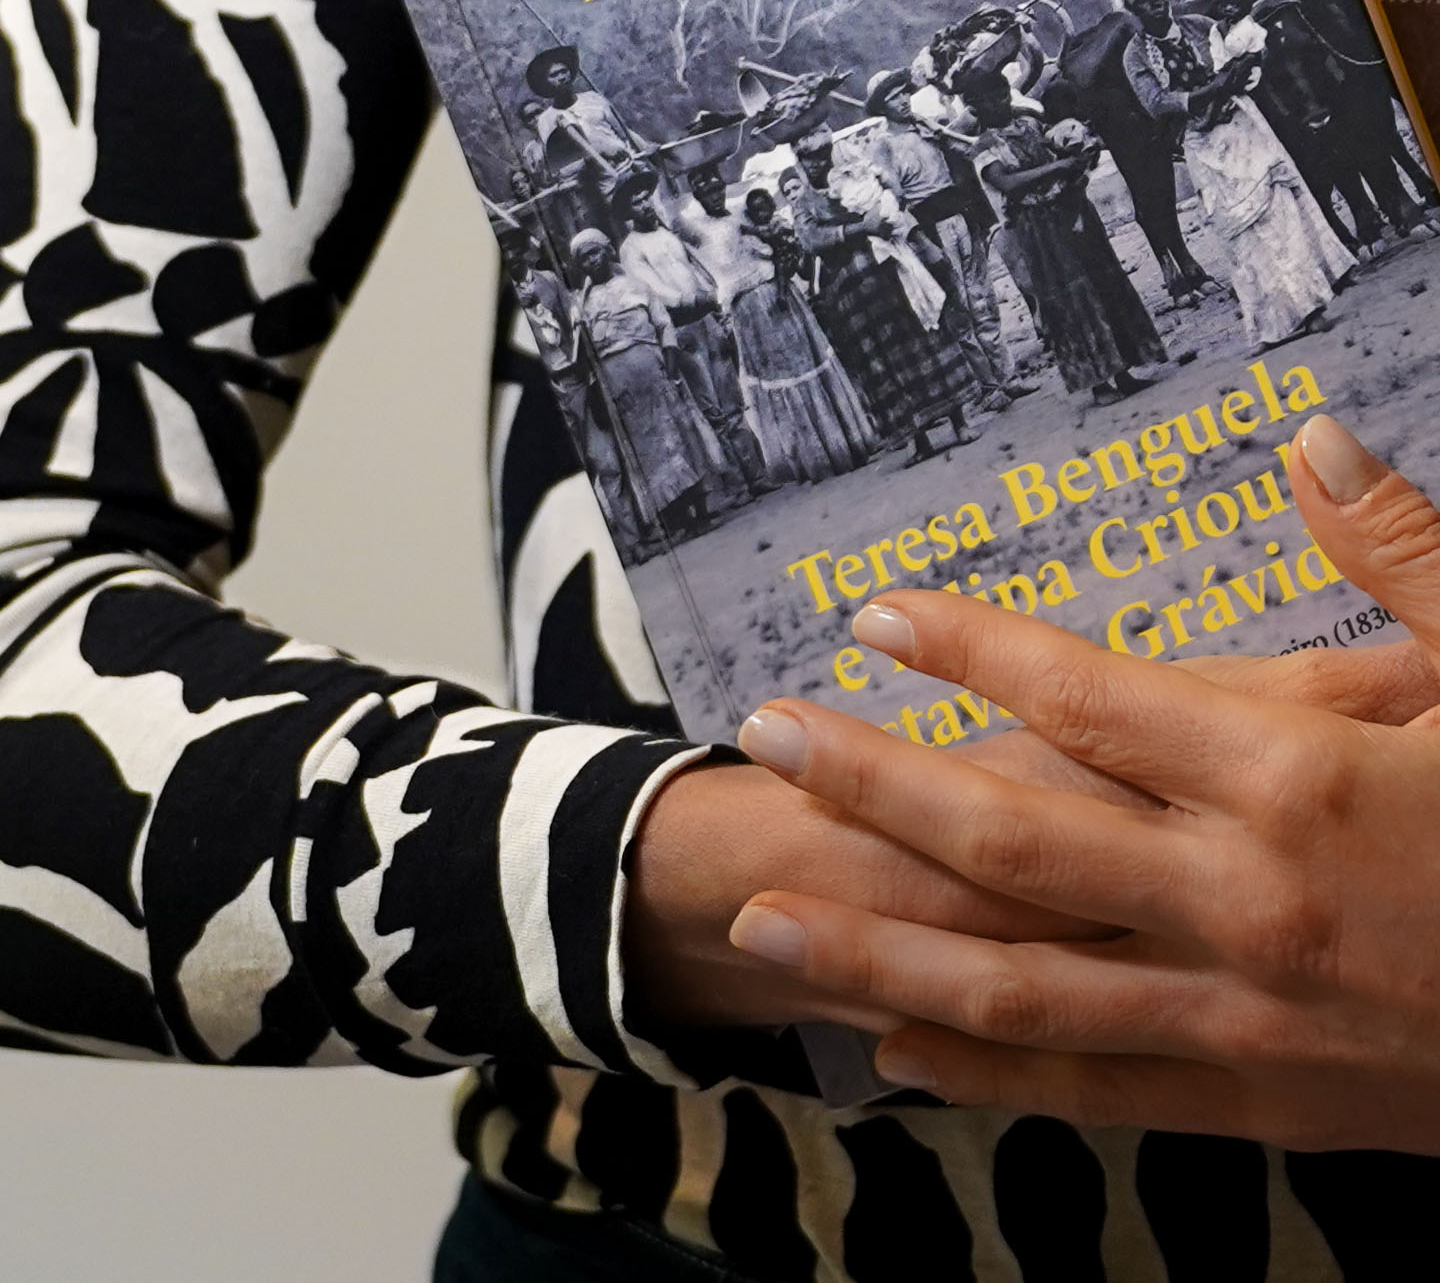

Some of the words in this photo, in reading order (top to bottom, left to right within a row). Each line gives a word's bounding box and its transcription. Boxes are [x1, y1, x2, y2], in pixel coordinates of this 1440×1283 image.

[786, 502, 998, 614] Teresa
[998, 359, 1328, 528] Benguela
[833, 646, 871, 691] e
[1088, 442, 1296, 579] Criou
[1107, 529, 1345, 660] Grávid
